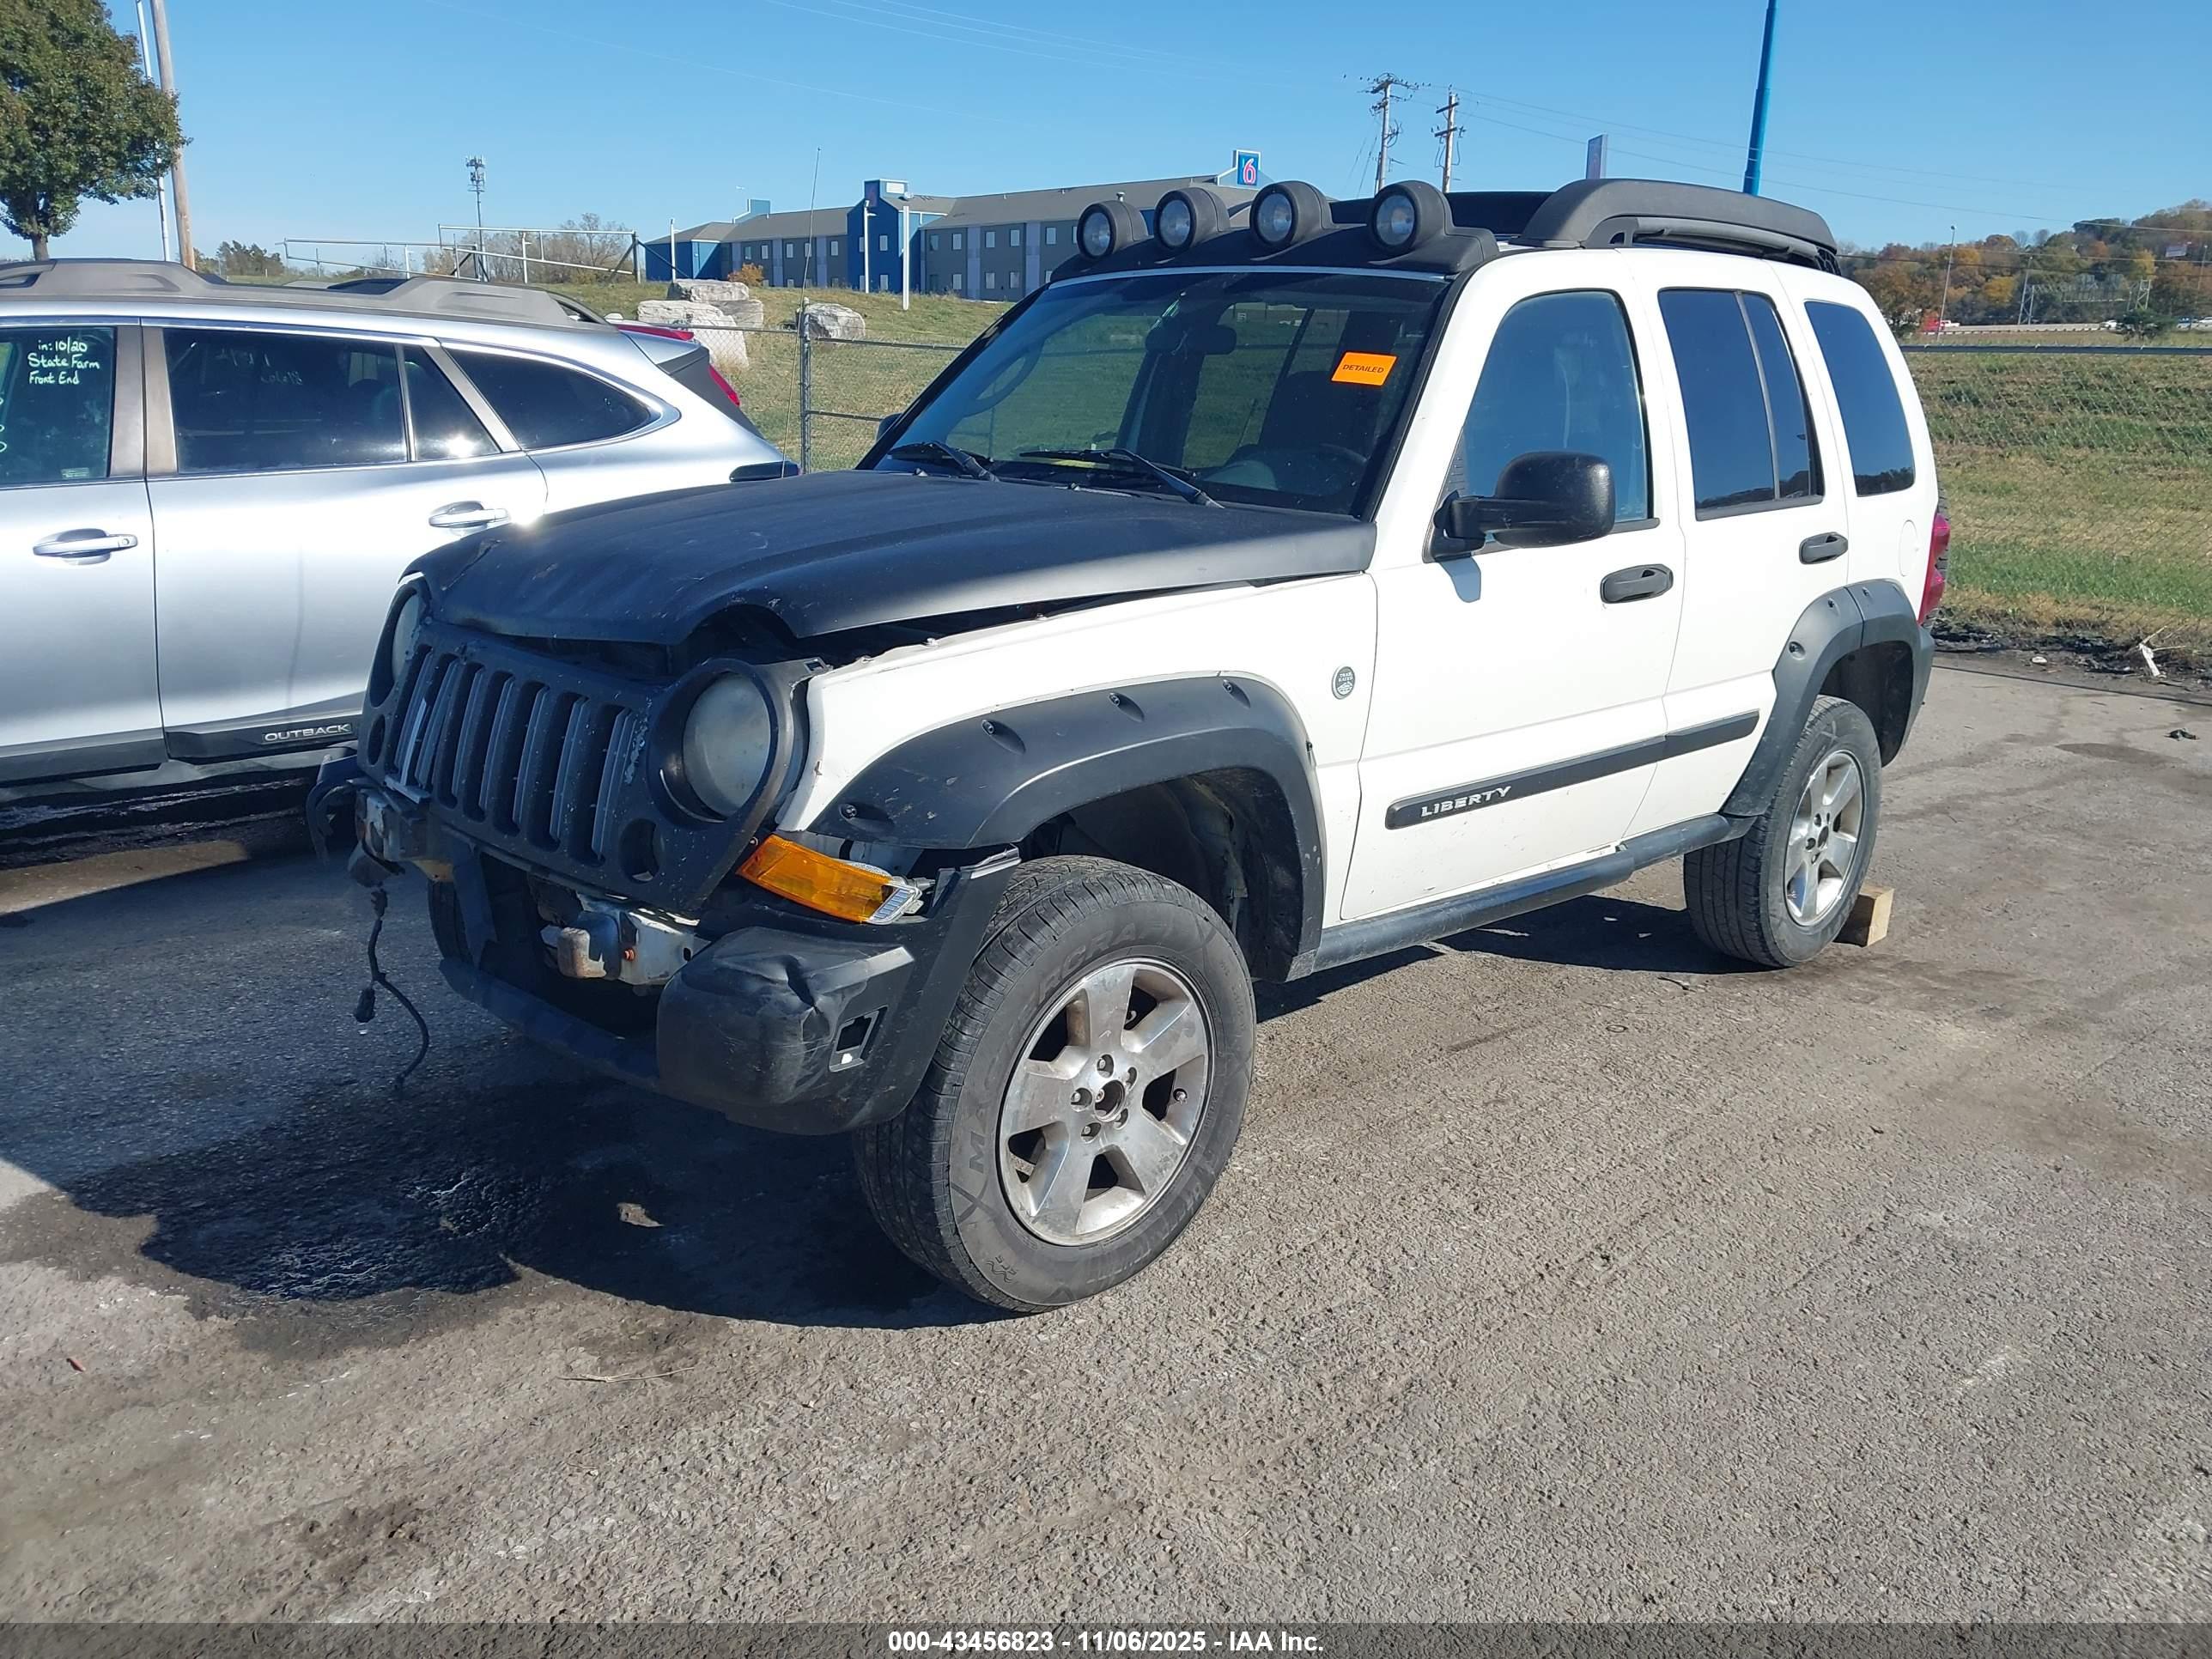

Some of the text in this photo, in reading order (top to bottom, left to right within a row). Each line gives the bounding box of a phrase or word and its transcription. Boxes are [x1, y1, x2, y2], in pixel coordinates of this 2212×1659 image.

[1243, 158, 1256, 185] 6
[27, 352, 100, 369] State Farm
[1342, 364, 1384, 373] DETAILED
[29, 369, 80, 385] Front End
[264, 724, 350, 741] OUTBACK
[1421, 786, 1511, 817] LIBERTY
